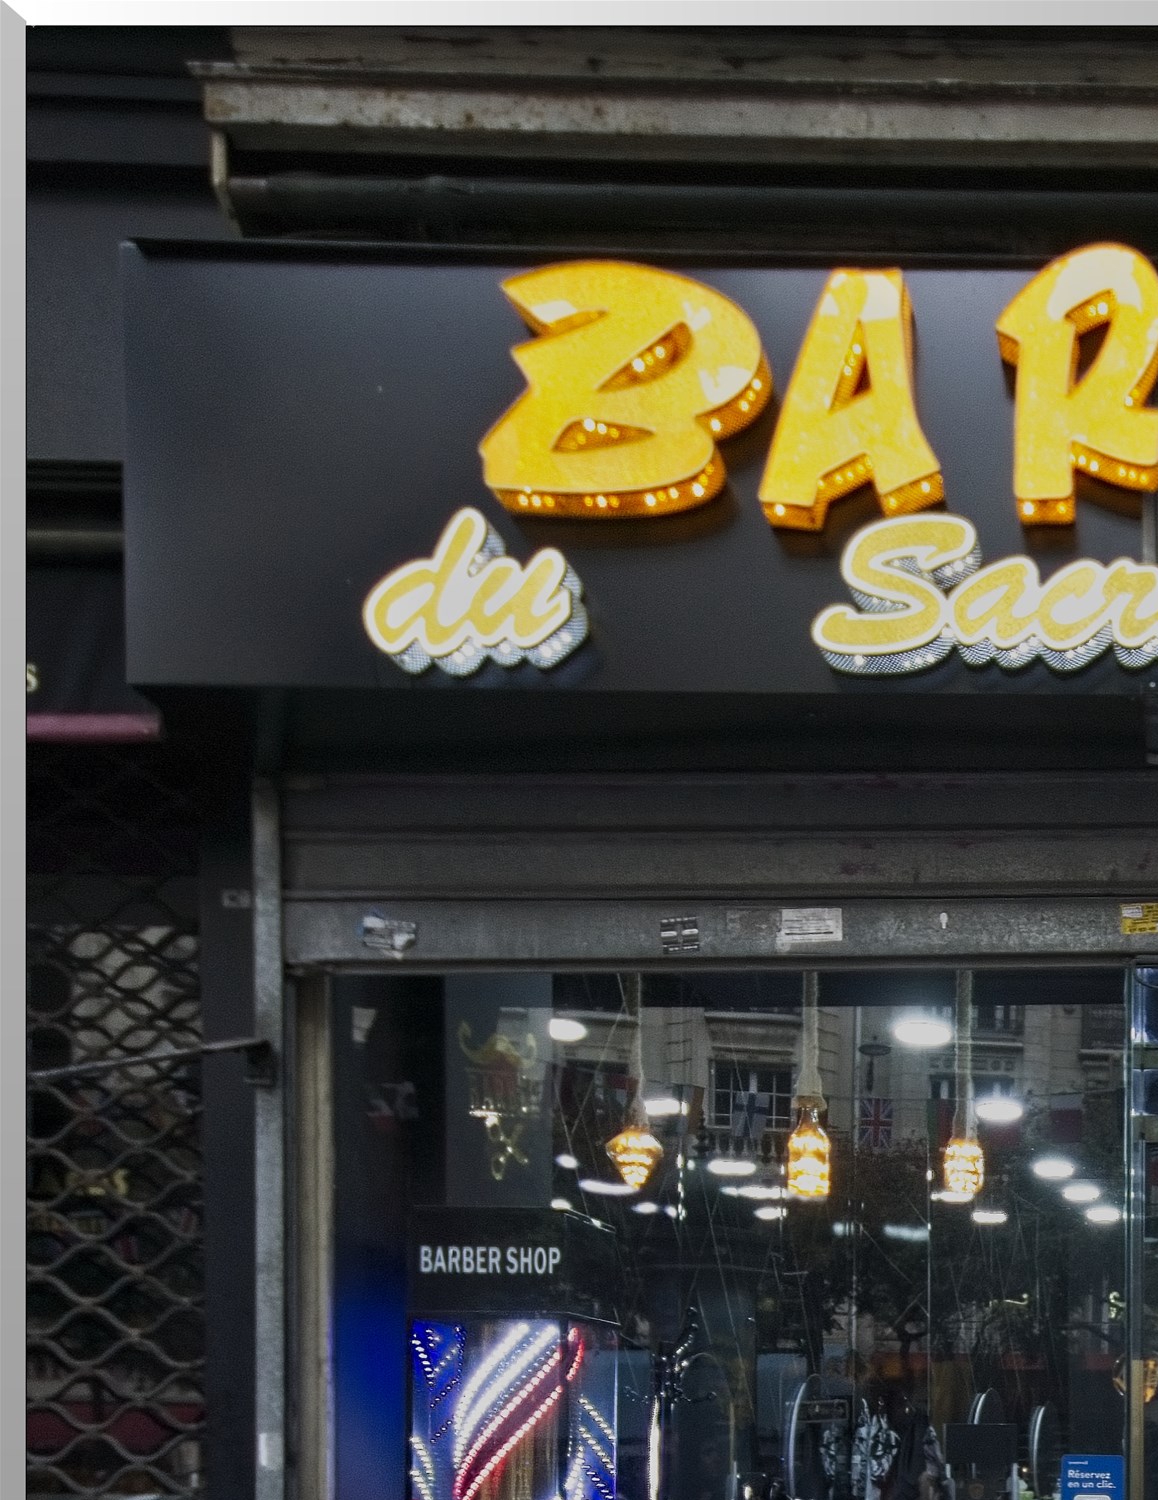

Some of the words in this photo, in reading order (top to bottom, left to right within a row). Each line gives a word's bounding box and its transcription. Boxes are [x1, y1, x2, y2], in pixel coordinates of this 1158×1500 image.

[363, 506, 587, 674] du
[419, 1244, 500, 1273] BARBER
[505, 1246, 561, 1274] SHOP
[1067, 1469, 1111, 1479] Réservez
